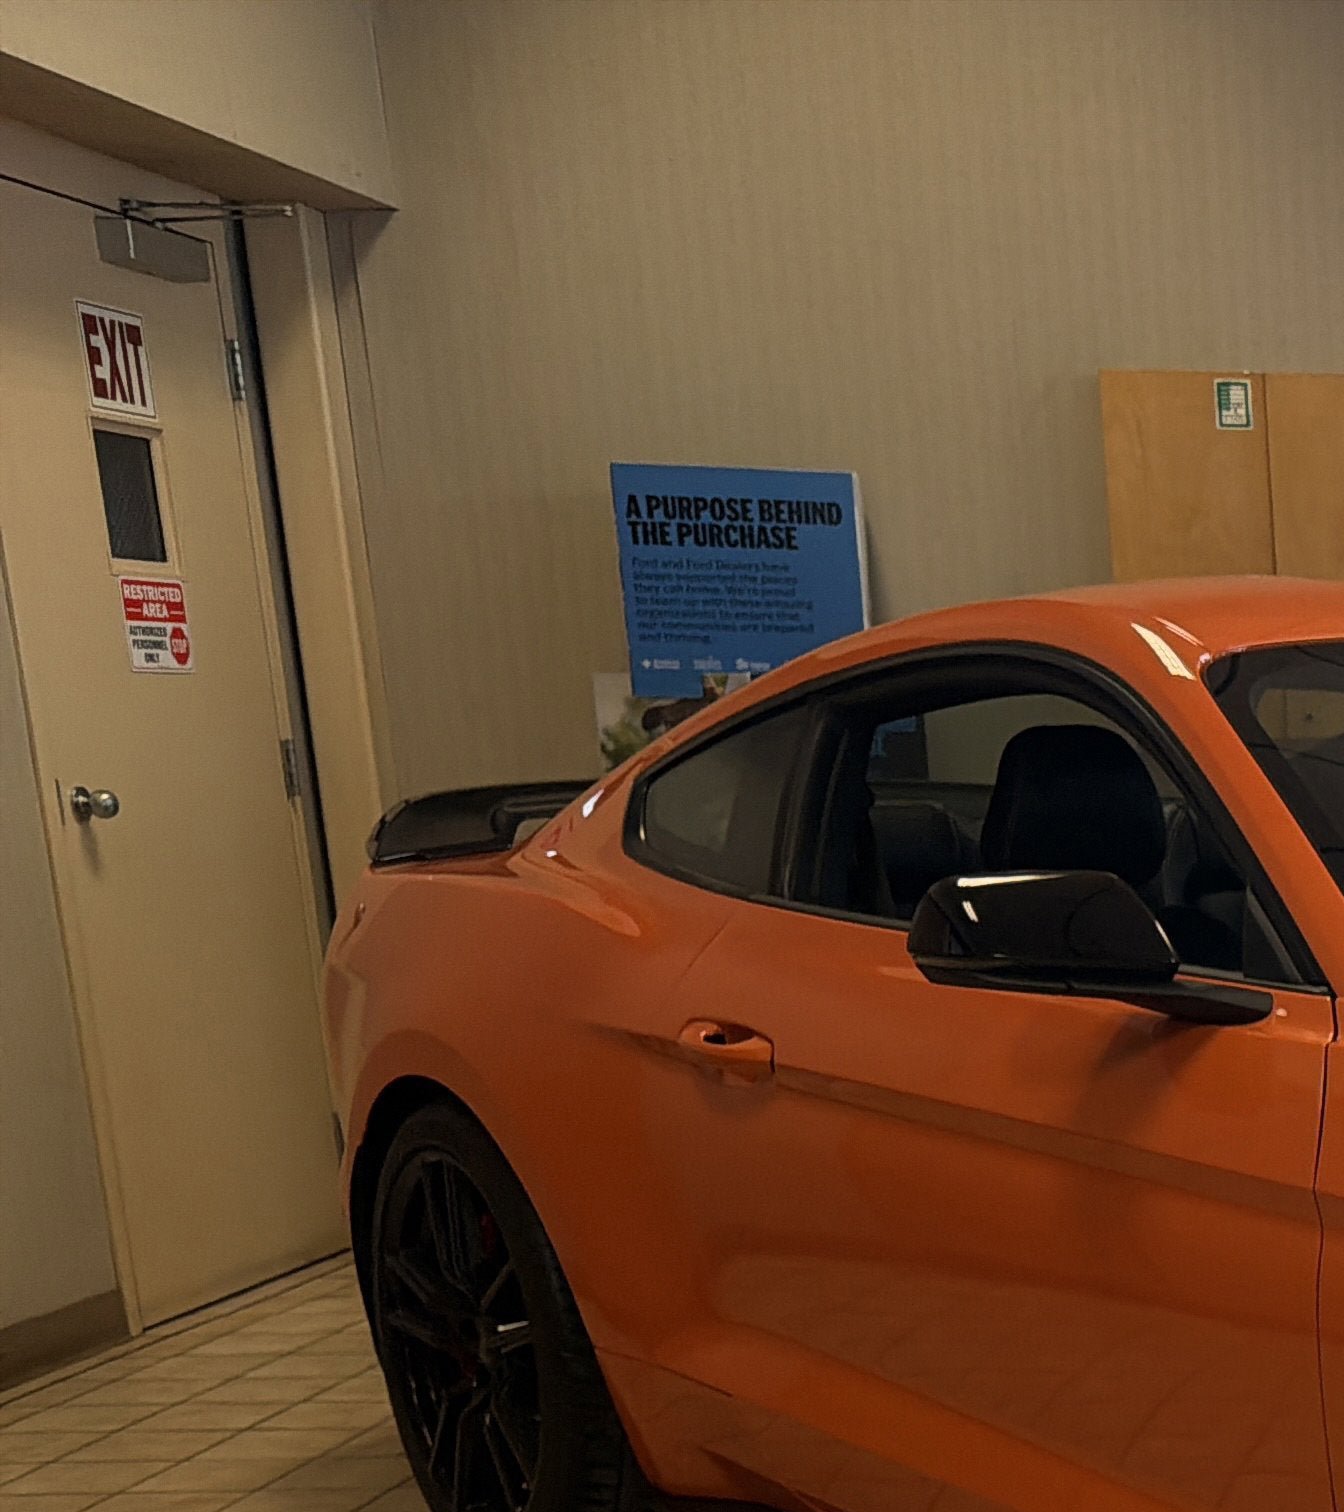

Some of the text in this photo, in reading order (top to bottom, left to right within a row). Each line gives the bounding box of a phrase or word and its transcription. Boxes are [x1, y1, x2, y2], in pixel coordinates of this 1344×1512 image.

[81, 312, 147, 407] EXIT
[626, 494, 843, 527] A PURPOSE BEHIND
[627, 520, 799, 550] THE PURCHASE
[123, 583, 182, 602] RESTRICTED
[143, 602, 169, 618] AREA
[132, 639, 168, 651] PERSONNEL
[144, 653, 160, 663] ONLY
